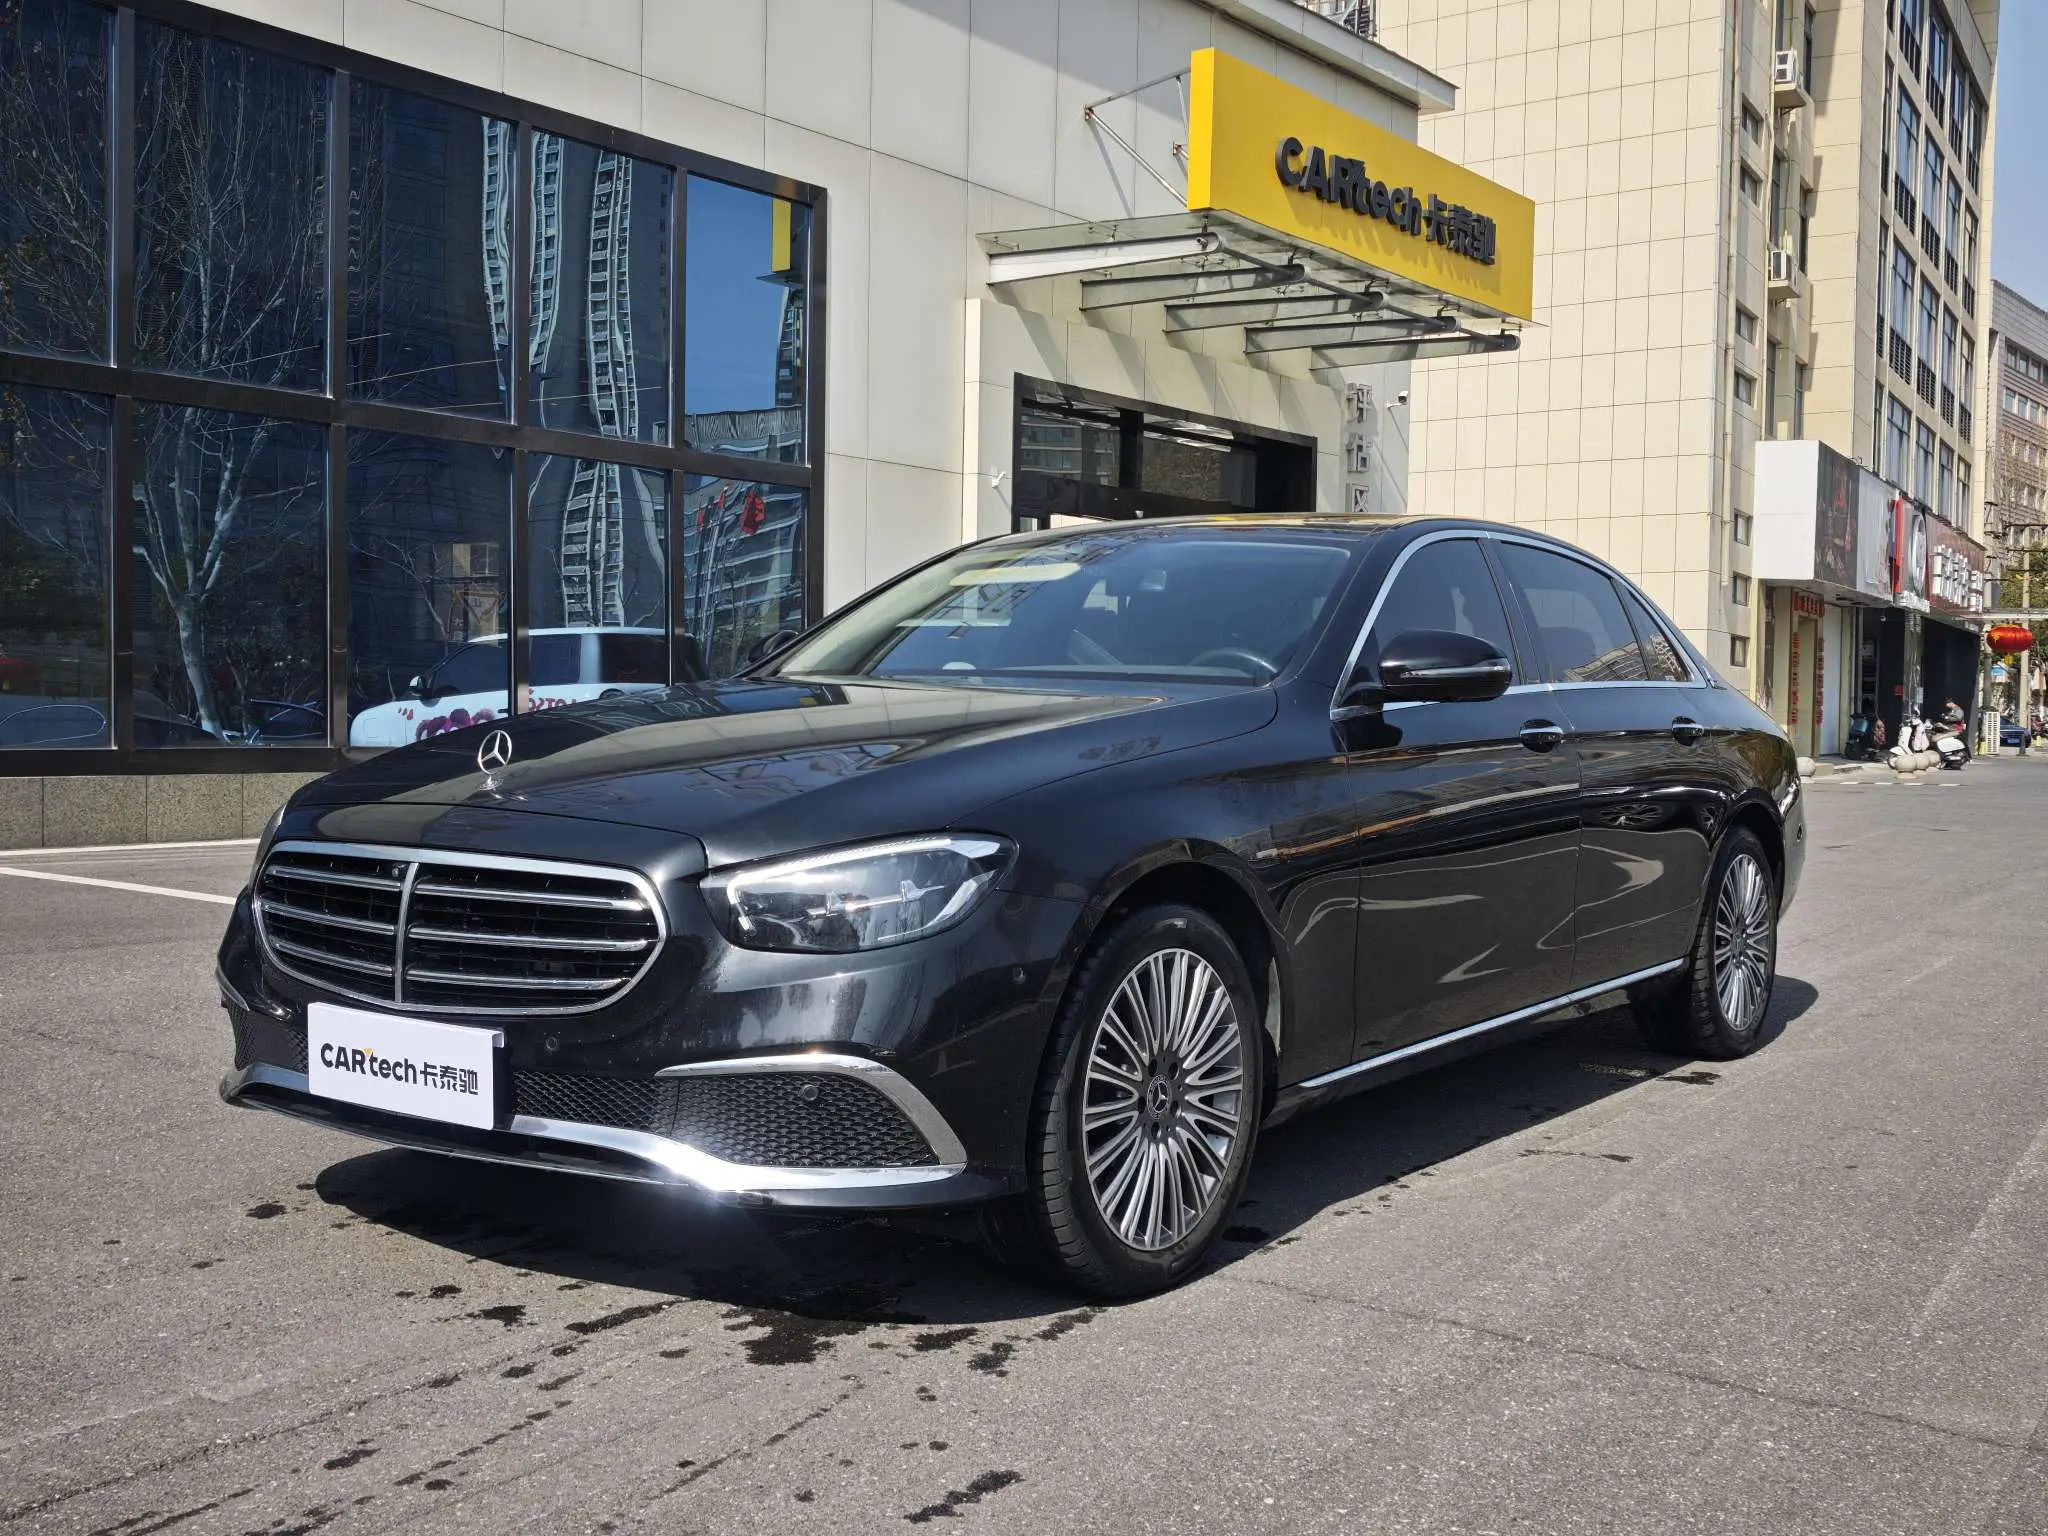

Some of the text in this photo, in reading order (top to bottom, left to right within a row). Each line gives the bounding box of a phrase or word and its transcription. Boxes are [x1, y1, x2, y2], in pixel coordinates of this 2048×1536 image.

[1275, 136, 1422, 236] CARtech
[320, 1042, 479, 1096] CARtech 卡泰驰
